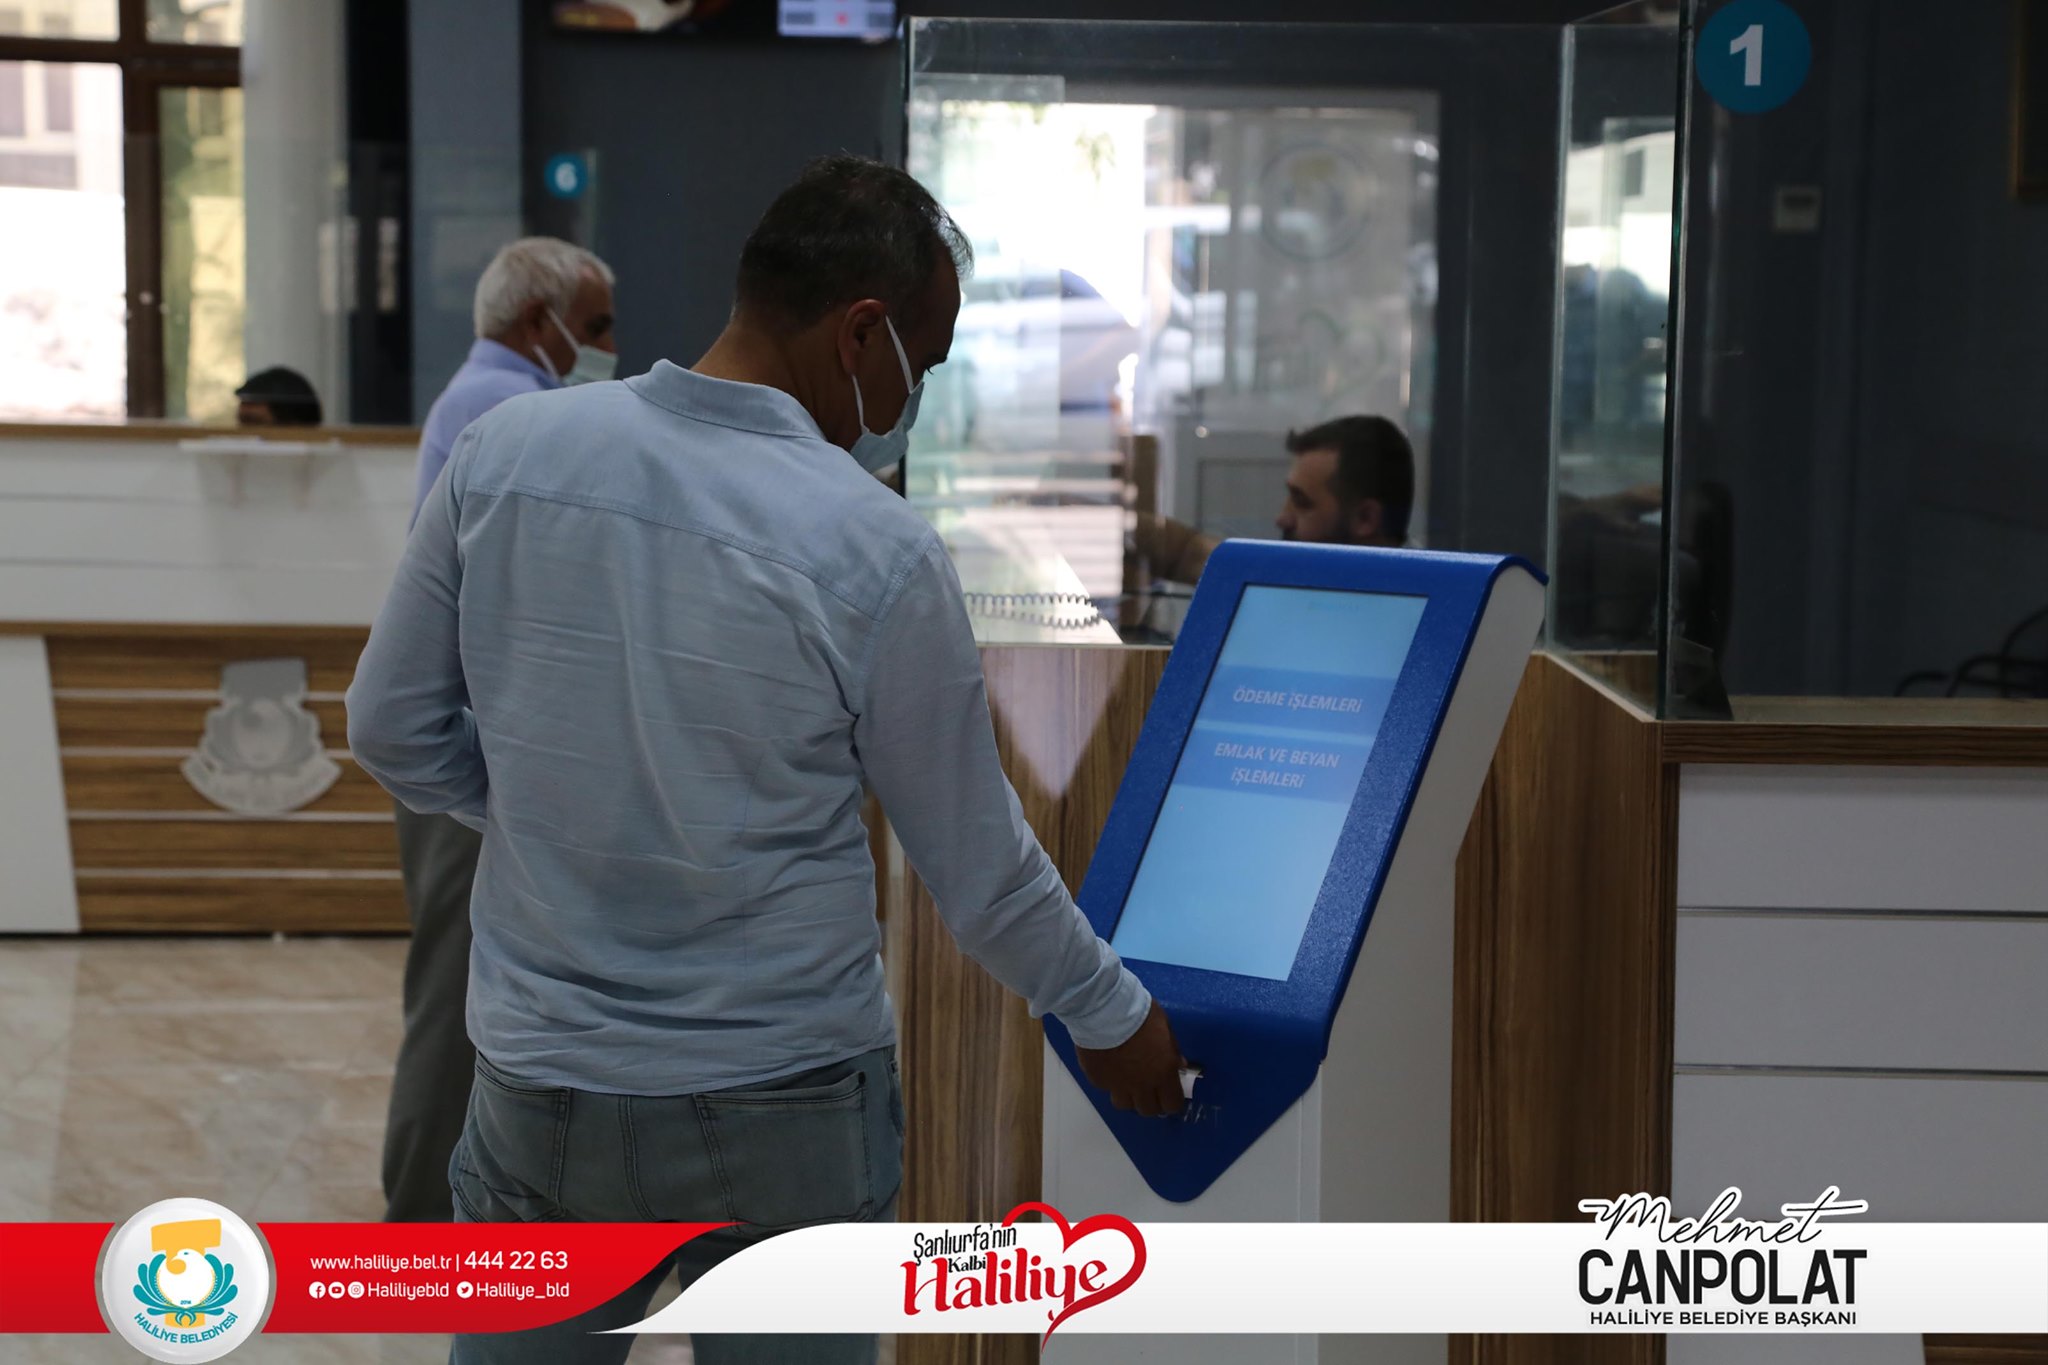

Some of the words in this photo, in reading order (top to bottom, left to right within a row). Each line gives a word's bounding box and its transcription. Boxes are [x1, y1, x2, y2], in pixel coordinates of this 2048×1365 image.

[1729, 24, 1764, 87] 1
[555, 165, 577, 190] 6
[1233, 686, 1286, 706] ÖDEME
[1215, 743, 1266, 761] EMLAK
[1269, 748, 1288, 763] VE
[1290, 750, 1340, 768] BEYAN
